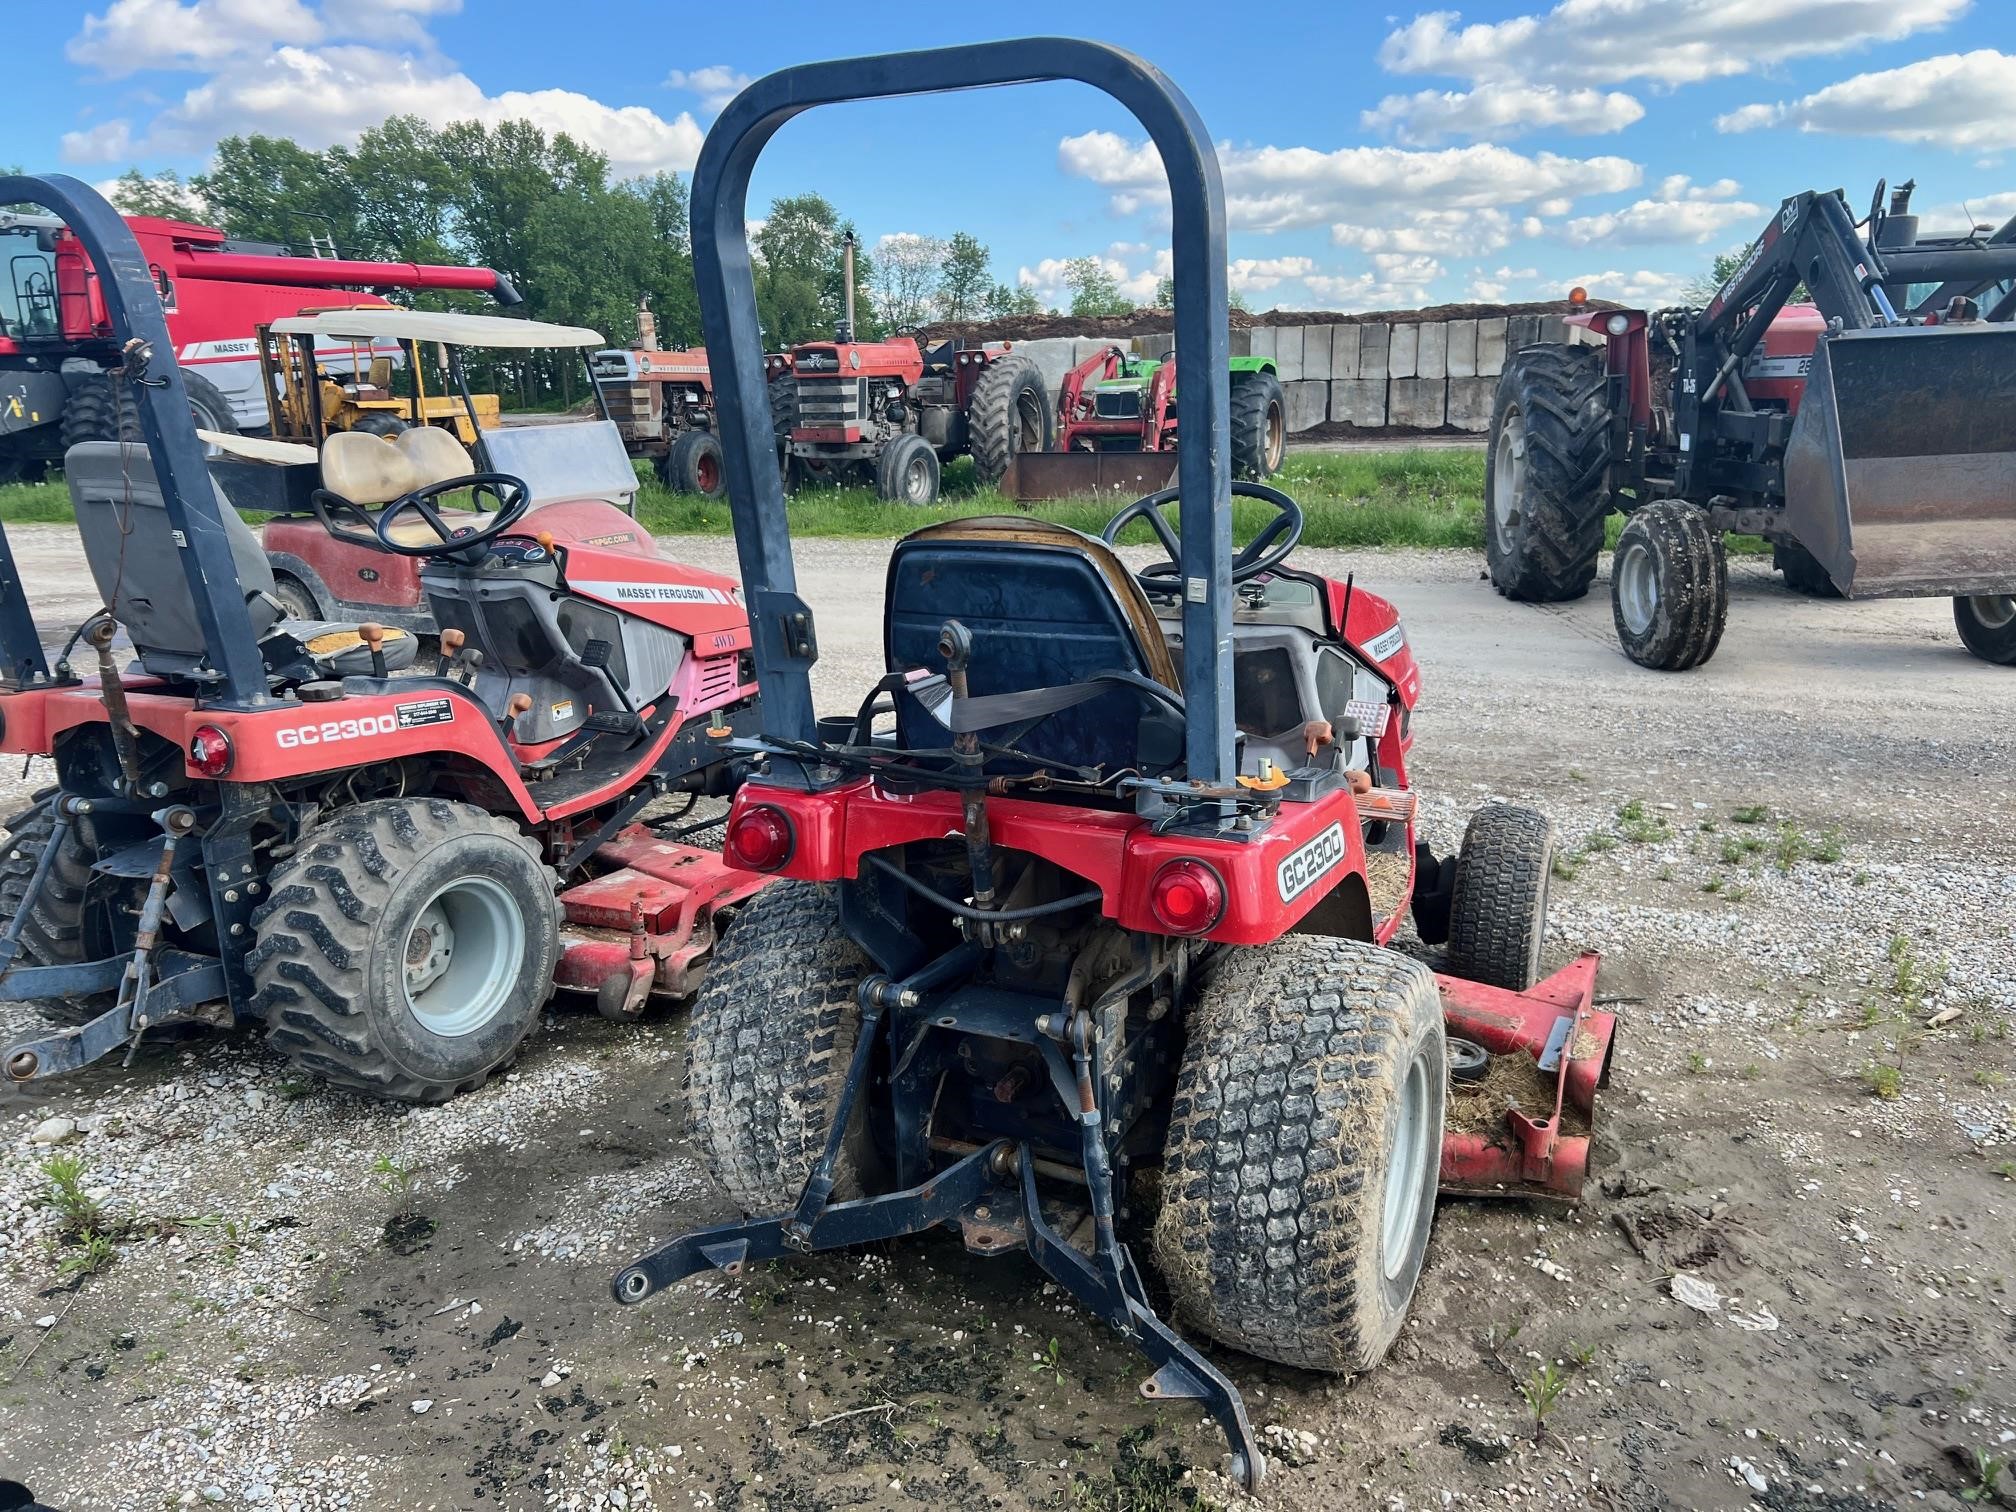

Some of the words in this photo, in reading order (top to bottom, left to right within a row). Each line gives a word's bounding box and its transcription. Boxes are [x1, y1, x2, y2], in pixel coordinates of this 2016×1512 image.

[1721, 239, 1764, 303] WESTENDORF
[214, 342, 249, 353] MASSEY
[616, 588, 656, 599] MASSEY
[658, 588, 704, 600] FERGUSON
[714, 633, 735, 648] 4WD
[275, 714, 398, 749] GC2300
[1282, 829, 1341, 894] GC2300
